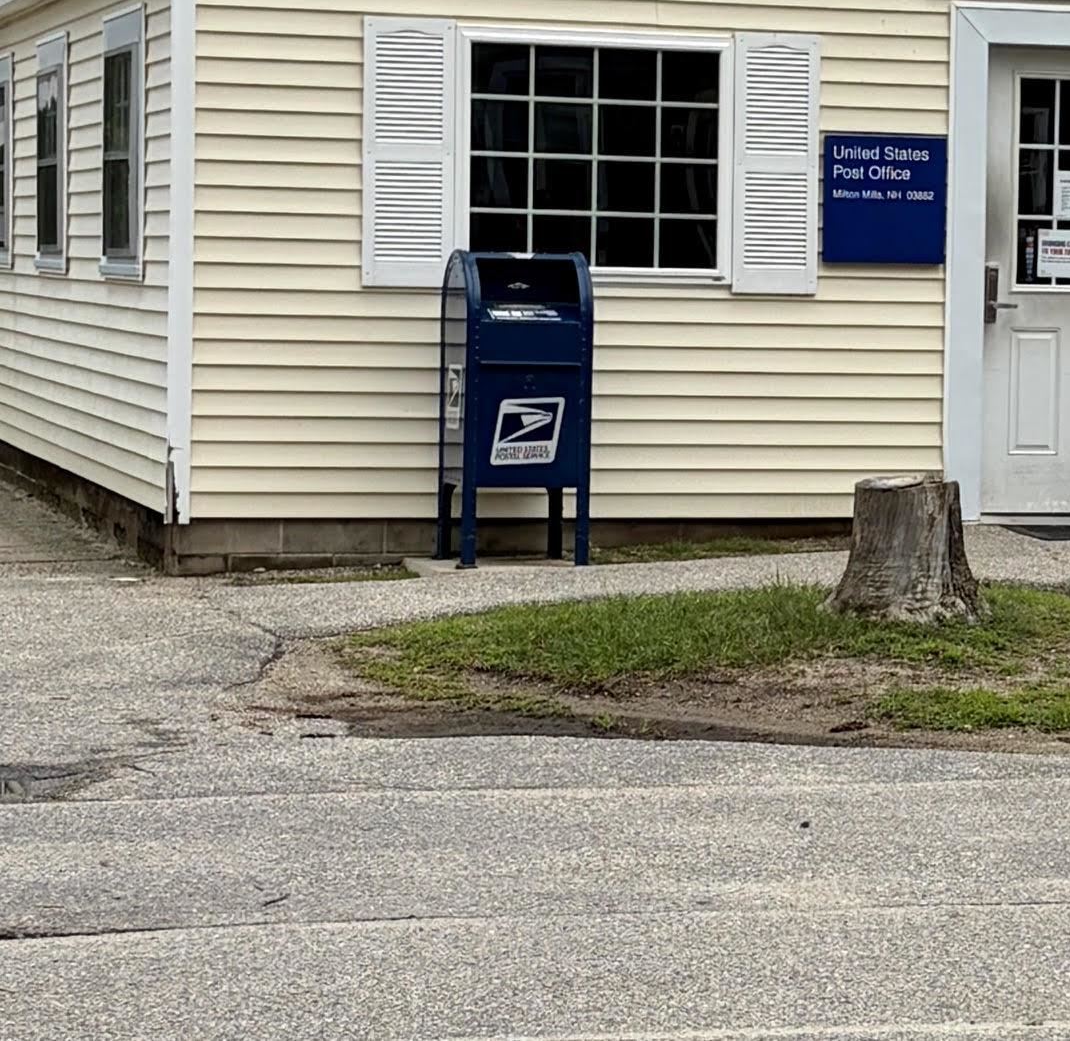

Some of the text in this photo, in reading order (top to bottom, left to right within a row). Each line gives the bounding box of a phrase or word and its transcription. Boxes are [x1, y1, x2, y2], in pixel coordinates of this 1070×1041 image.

[833, 145, 930, 161] United States
[833, 164, 911, 181] Post Office
[832, 189, 860, 199] Milton
